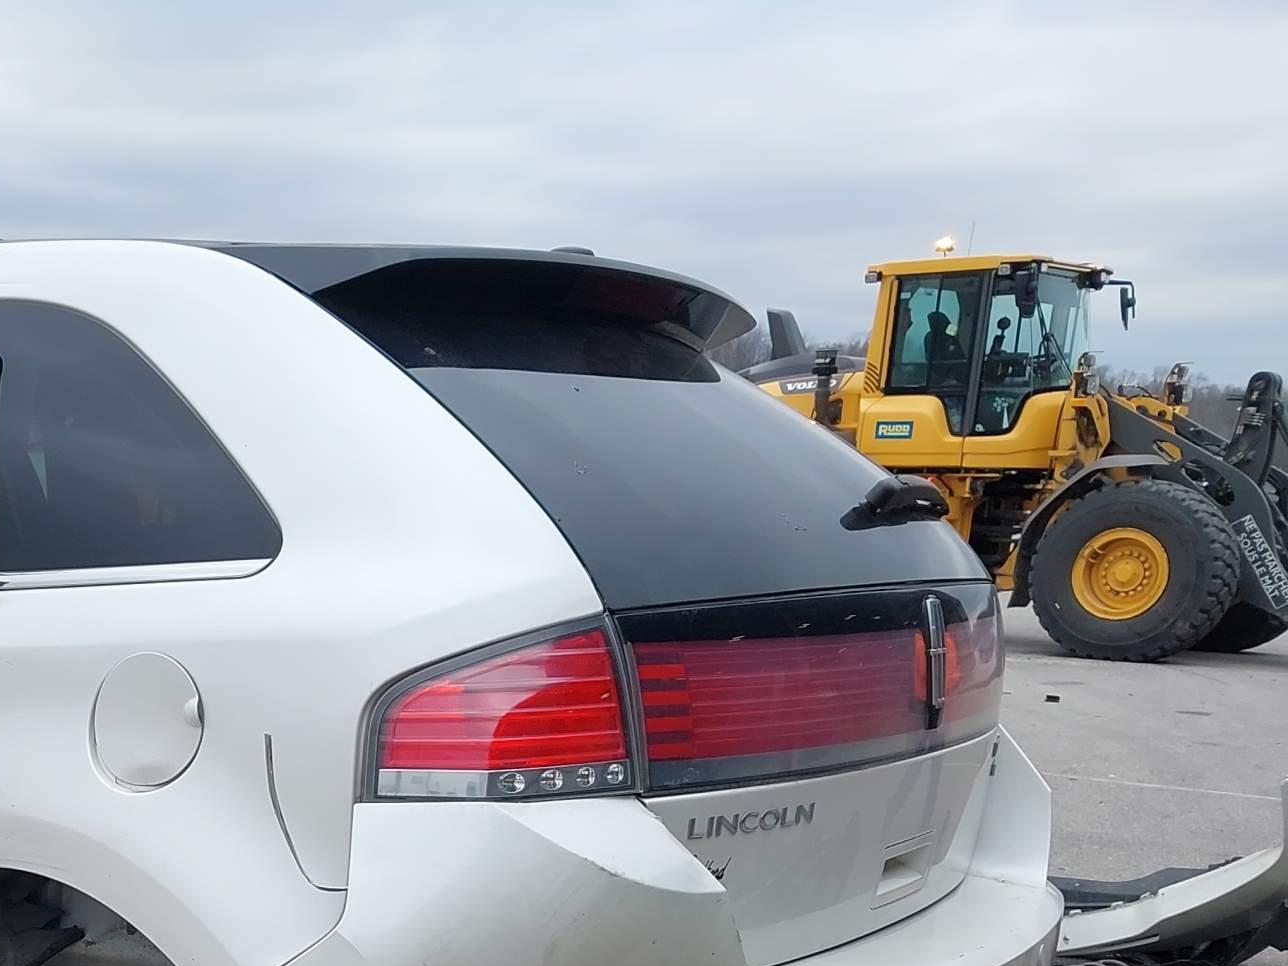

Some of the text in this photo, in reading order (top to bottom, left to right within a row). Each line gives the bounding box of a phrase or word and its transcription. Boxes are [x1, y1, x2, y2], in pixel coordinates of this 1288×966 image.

[785, 380, 838, 391] VOLO
[877, 424, 911, 436] RUDD
[1237, 532, 1259, 561] SOUS
[1253, 561, 1267, 576] LE
[1242, 516, 1288, 600] NE PAS MARCHE
[687, 801, 816, 840] LINCOLN
